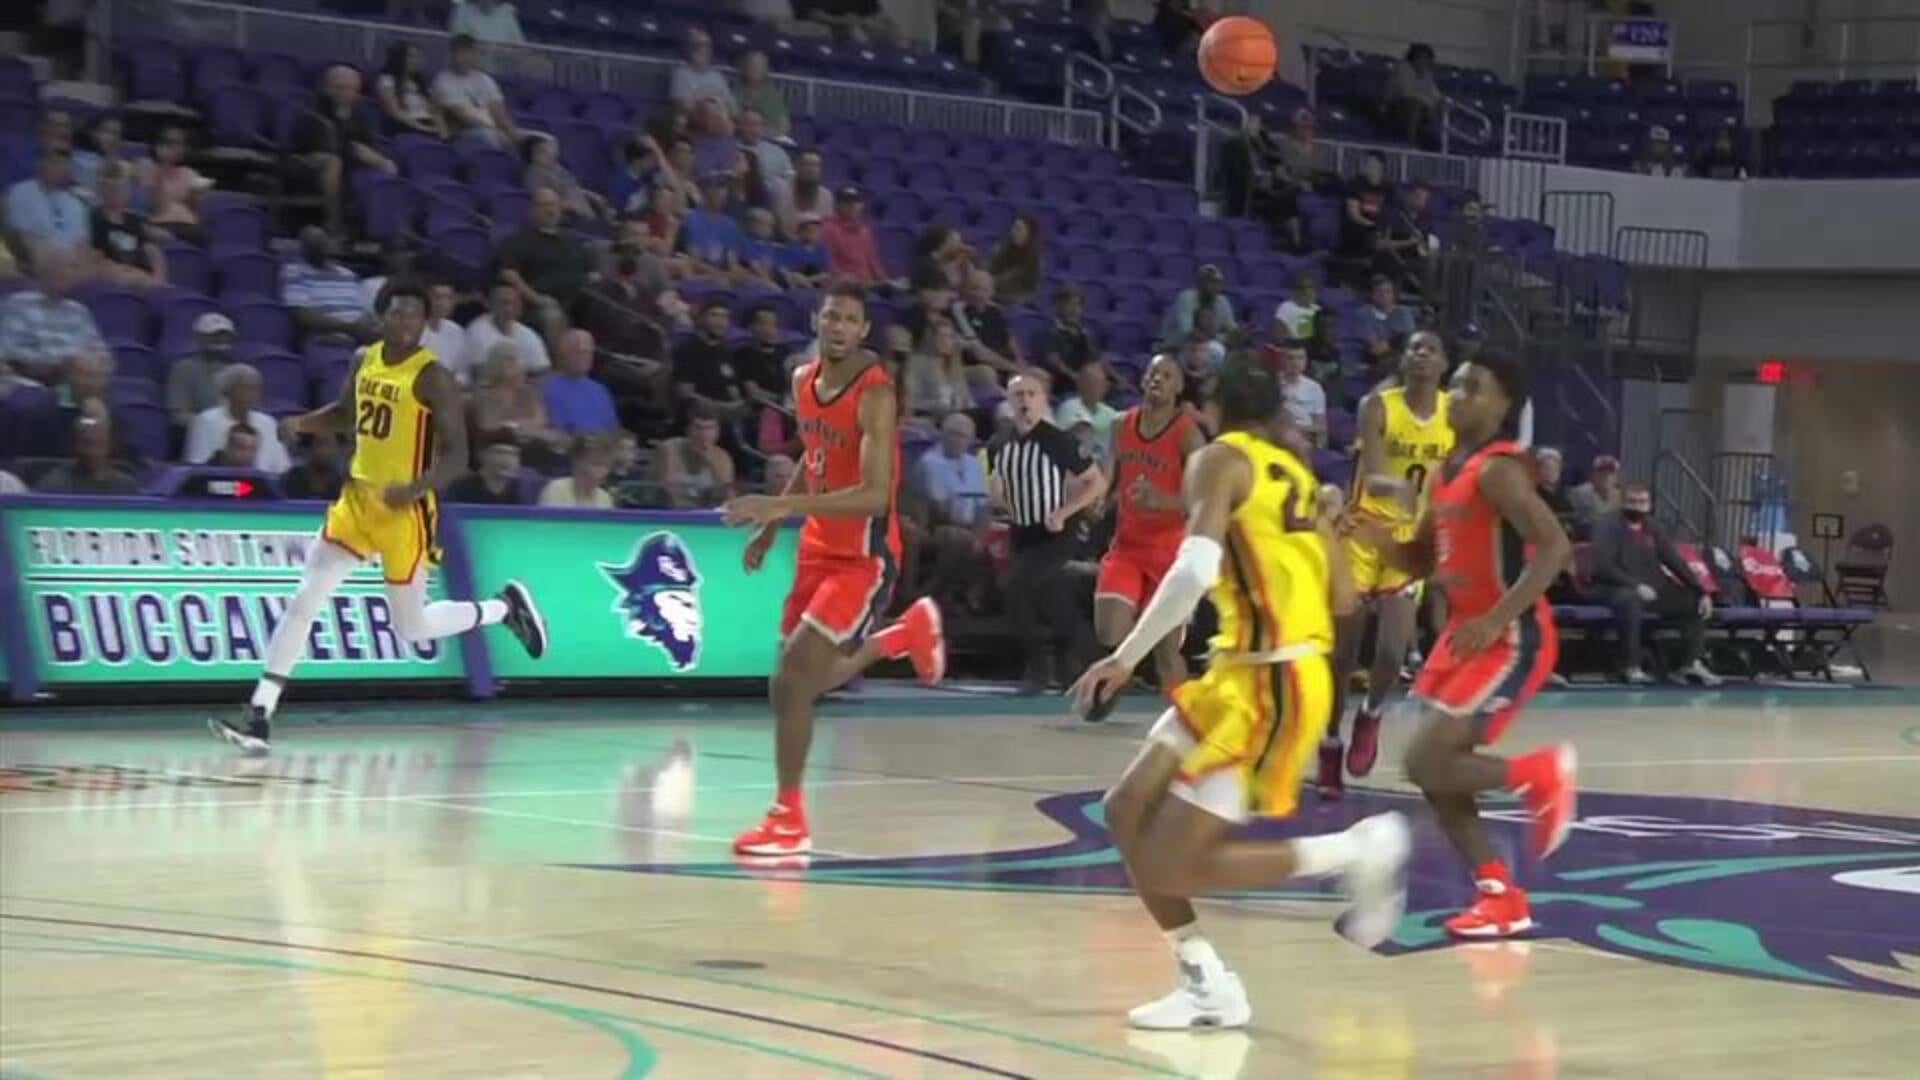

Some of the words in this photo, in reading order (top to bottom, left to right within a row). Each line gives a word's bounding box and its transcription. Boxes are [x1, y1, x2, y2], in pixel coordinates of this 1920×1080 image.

[358, 400, 392, 440] 20
[30, 530, 165, 567] FLORIDA
[41, 593, 439, 662] BUCCAEER
